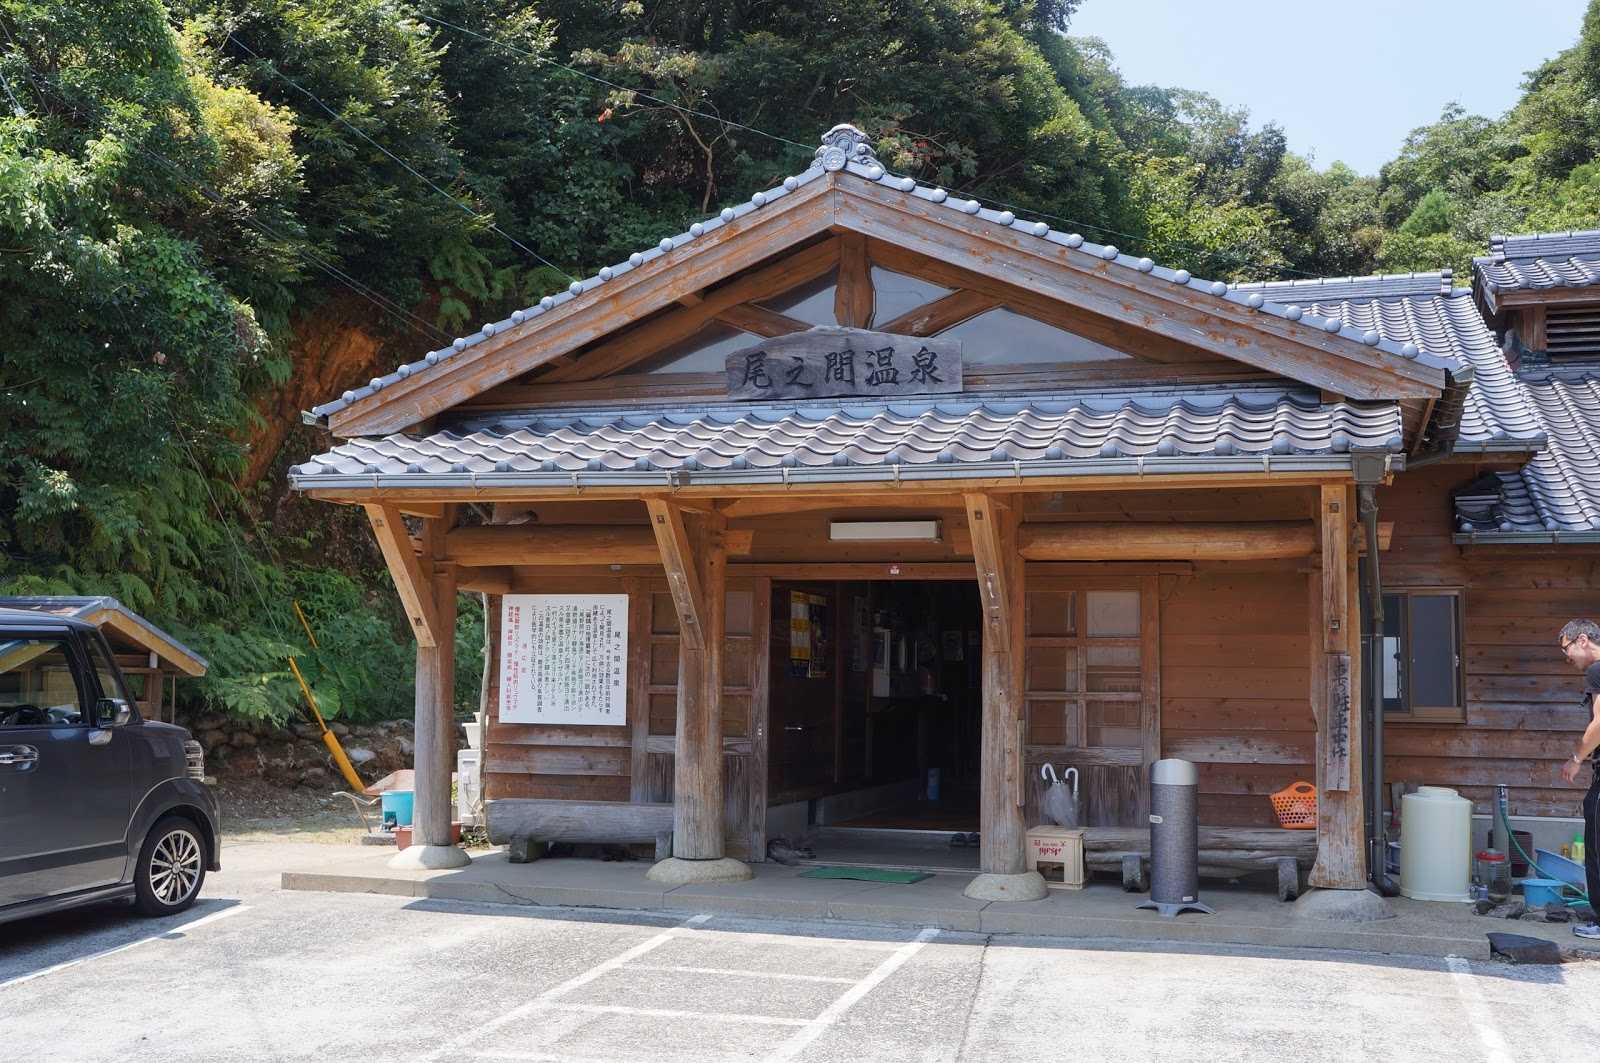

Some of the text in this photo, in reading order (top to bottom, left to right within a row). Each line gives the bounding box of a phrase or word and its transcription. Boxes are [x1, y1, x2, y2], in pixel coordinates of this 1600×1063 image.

[742, 346, 943, 389] 尾之間温泉
